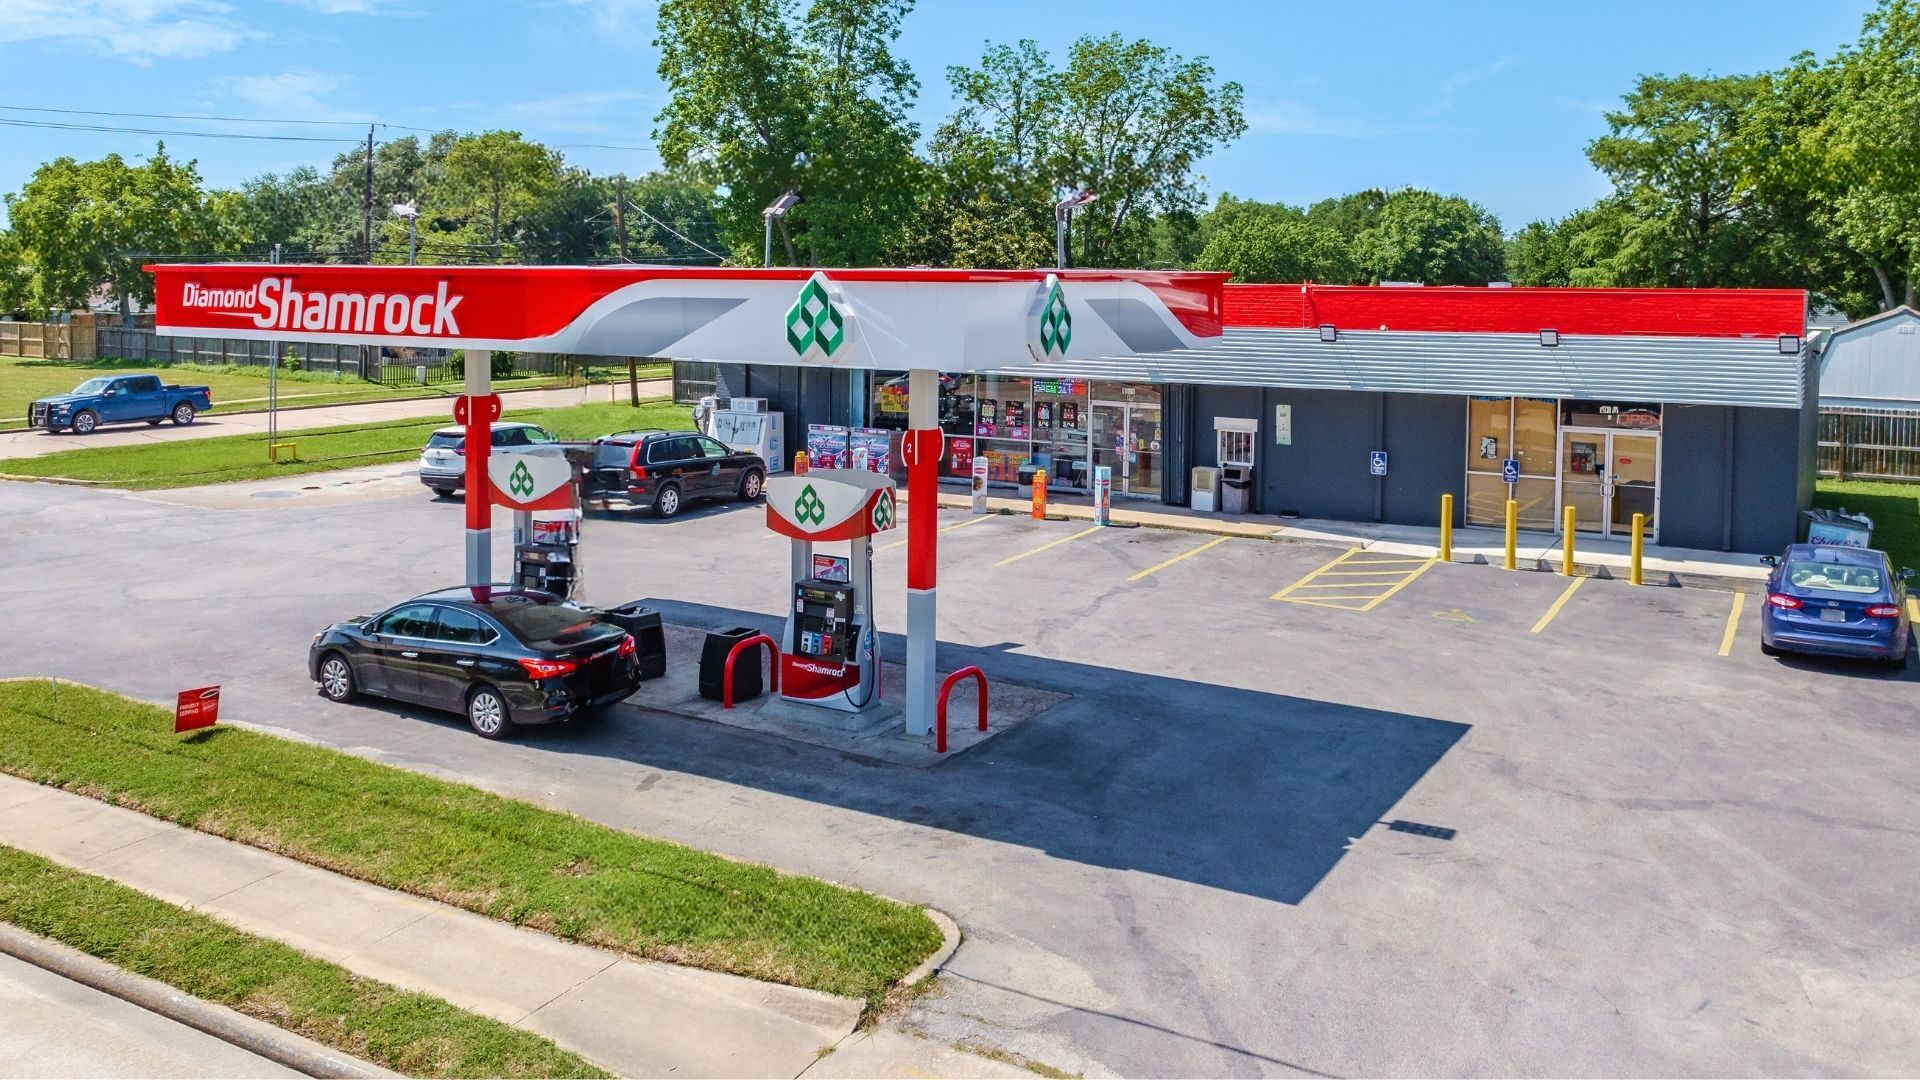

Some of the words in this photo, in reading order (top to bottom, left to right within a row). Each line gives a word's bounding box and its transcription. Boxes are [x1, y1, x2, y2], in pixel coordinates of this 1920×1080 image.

[182, 282, 258, 309] Diamond
[253, 277, 464, 335] Shamrock
[458, 407, 465, 416] 4
[491, 404, 497, 413] 3
[1617, 413, 1659, 426] OPEN
[769, 416, 779, 471] ICE
[906, 443, 913, 454] 2
